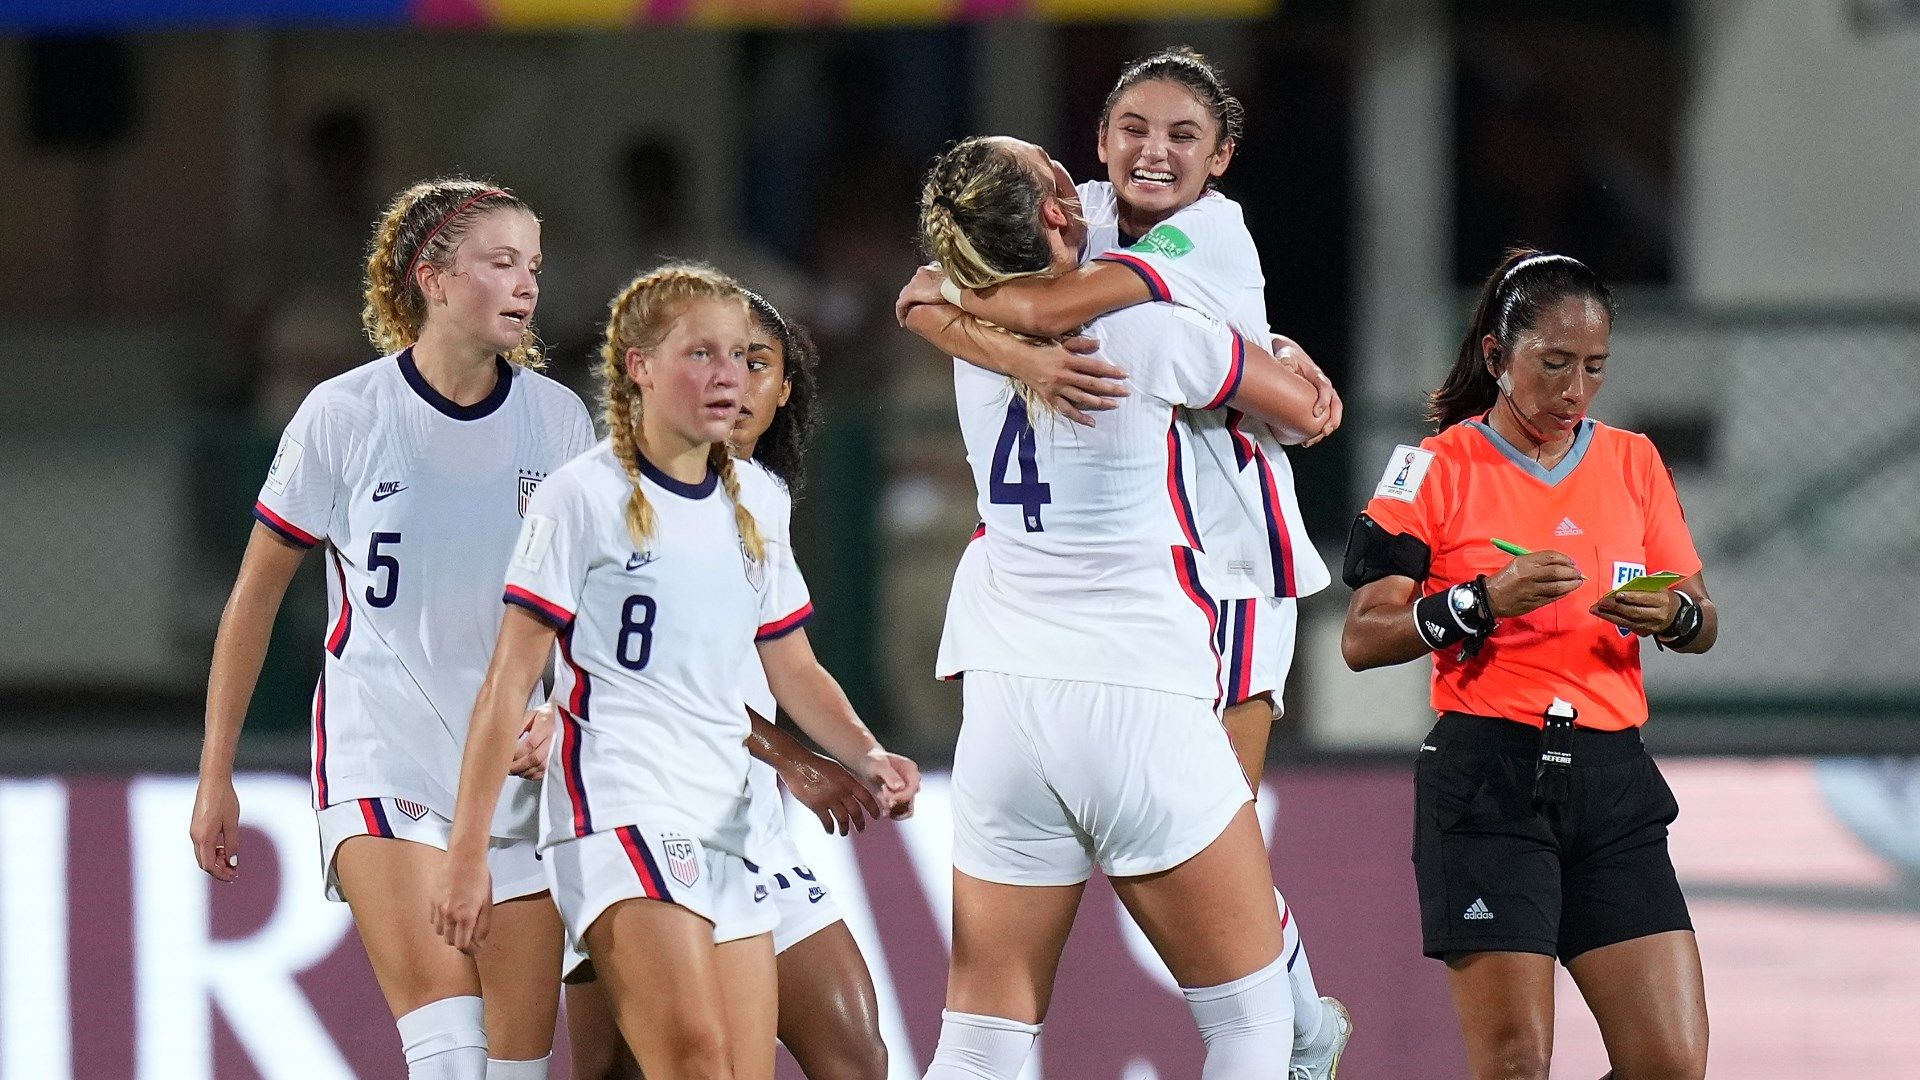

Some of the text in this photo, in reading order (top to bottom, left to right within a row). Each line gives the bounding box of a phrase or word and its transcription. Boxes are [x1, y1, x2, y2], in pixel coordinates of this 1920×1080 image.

[990, 391, 1051, 532] 4
[377, 481, 400, 493] NIKE
[365, 531, 402, 608] 5
[616, 594, 656, 670] 8
[667, 843, 692, 859] USA
[1463, 911, 1494, 920] adidas
